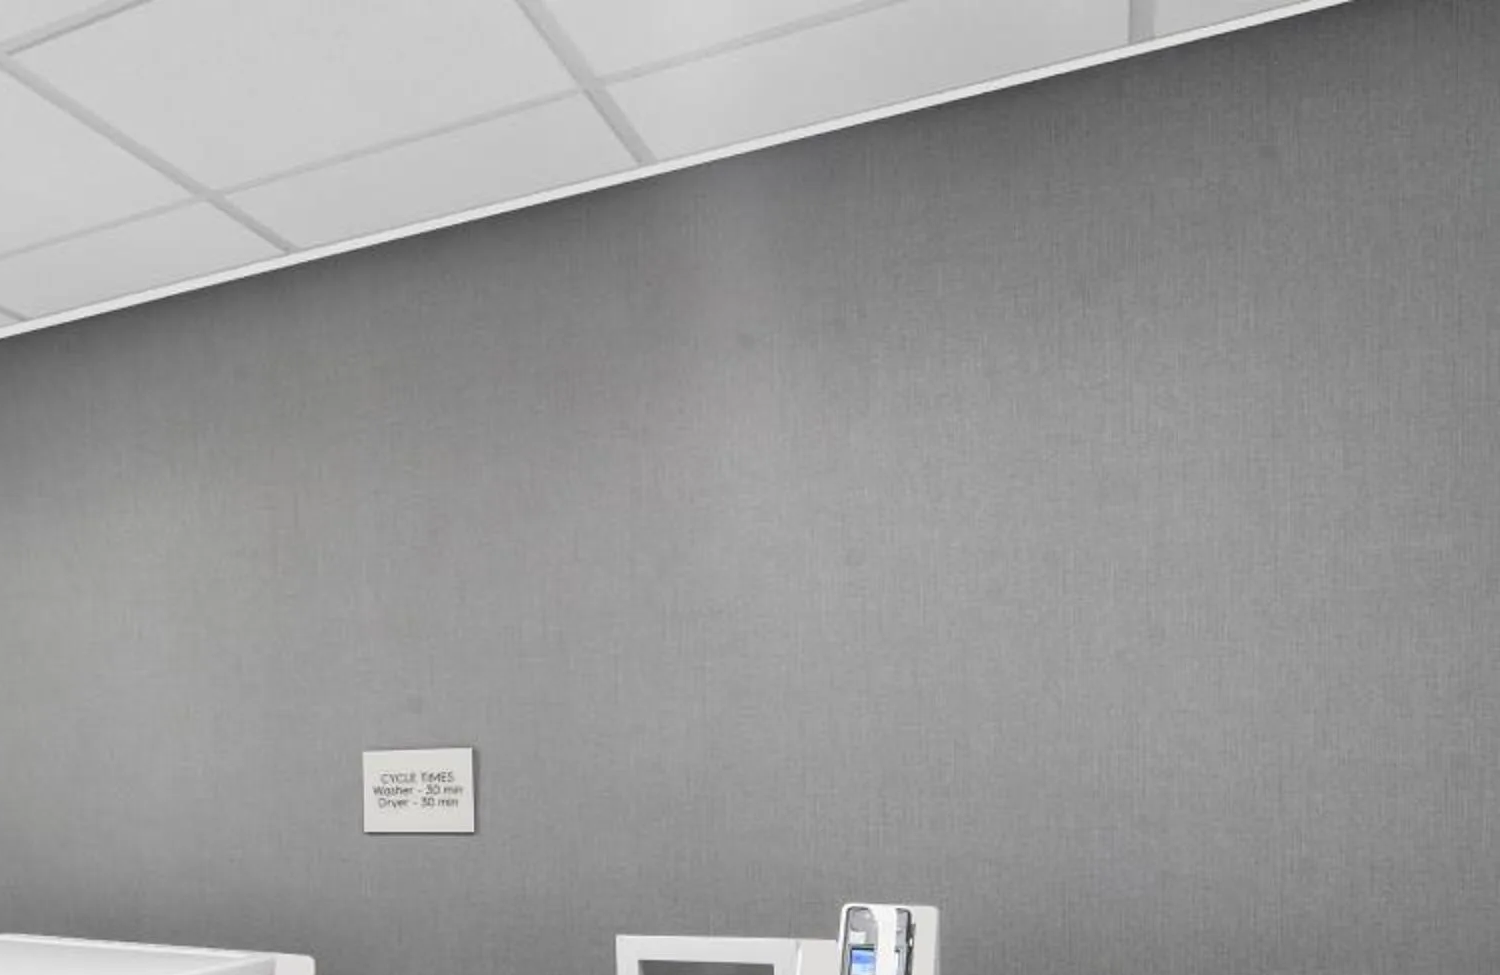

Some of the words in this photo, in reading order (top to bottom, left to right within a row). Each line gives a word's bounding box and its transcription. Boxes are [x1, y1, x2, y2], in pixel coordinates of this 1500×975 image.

[380, 771, 417, 785] CYCLE
[420, 769, 455, 783] TIMES
[372, 785, 414, 796] Washer
[443, 785, 464, 795] min
[378, 797, 409, 809] Dryer
[437, 797, 459, 808] min
